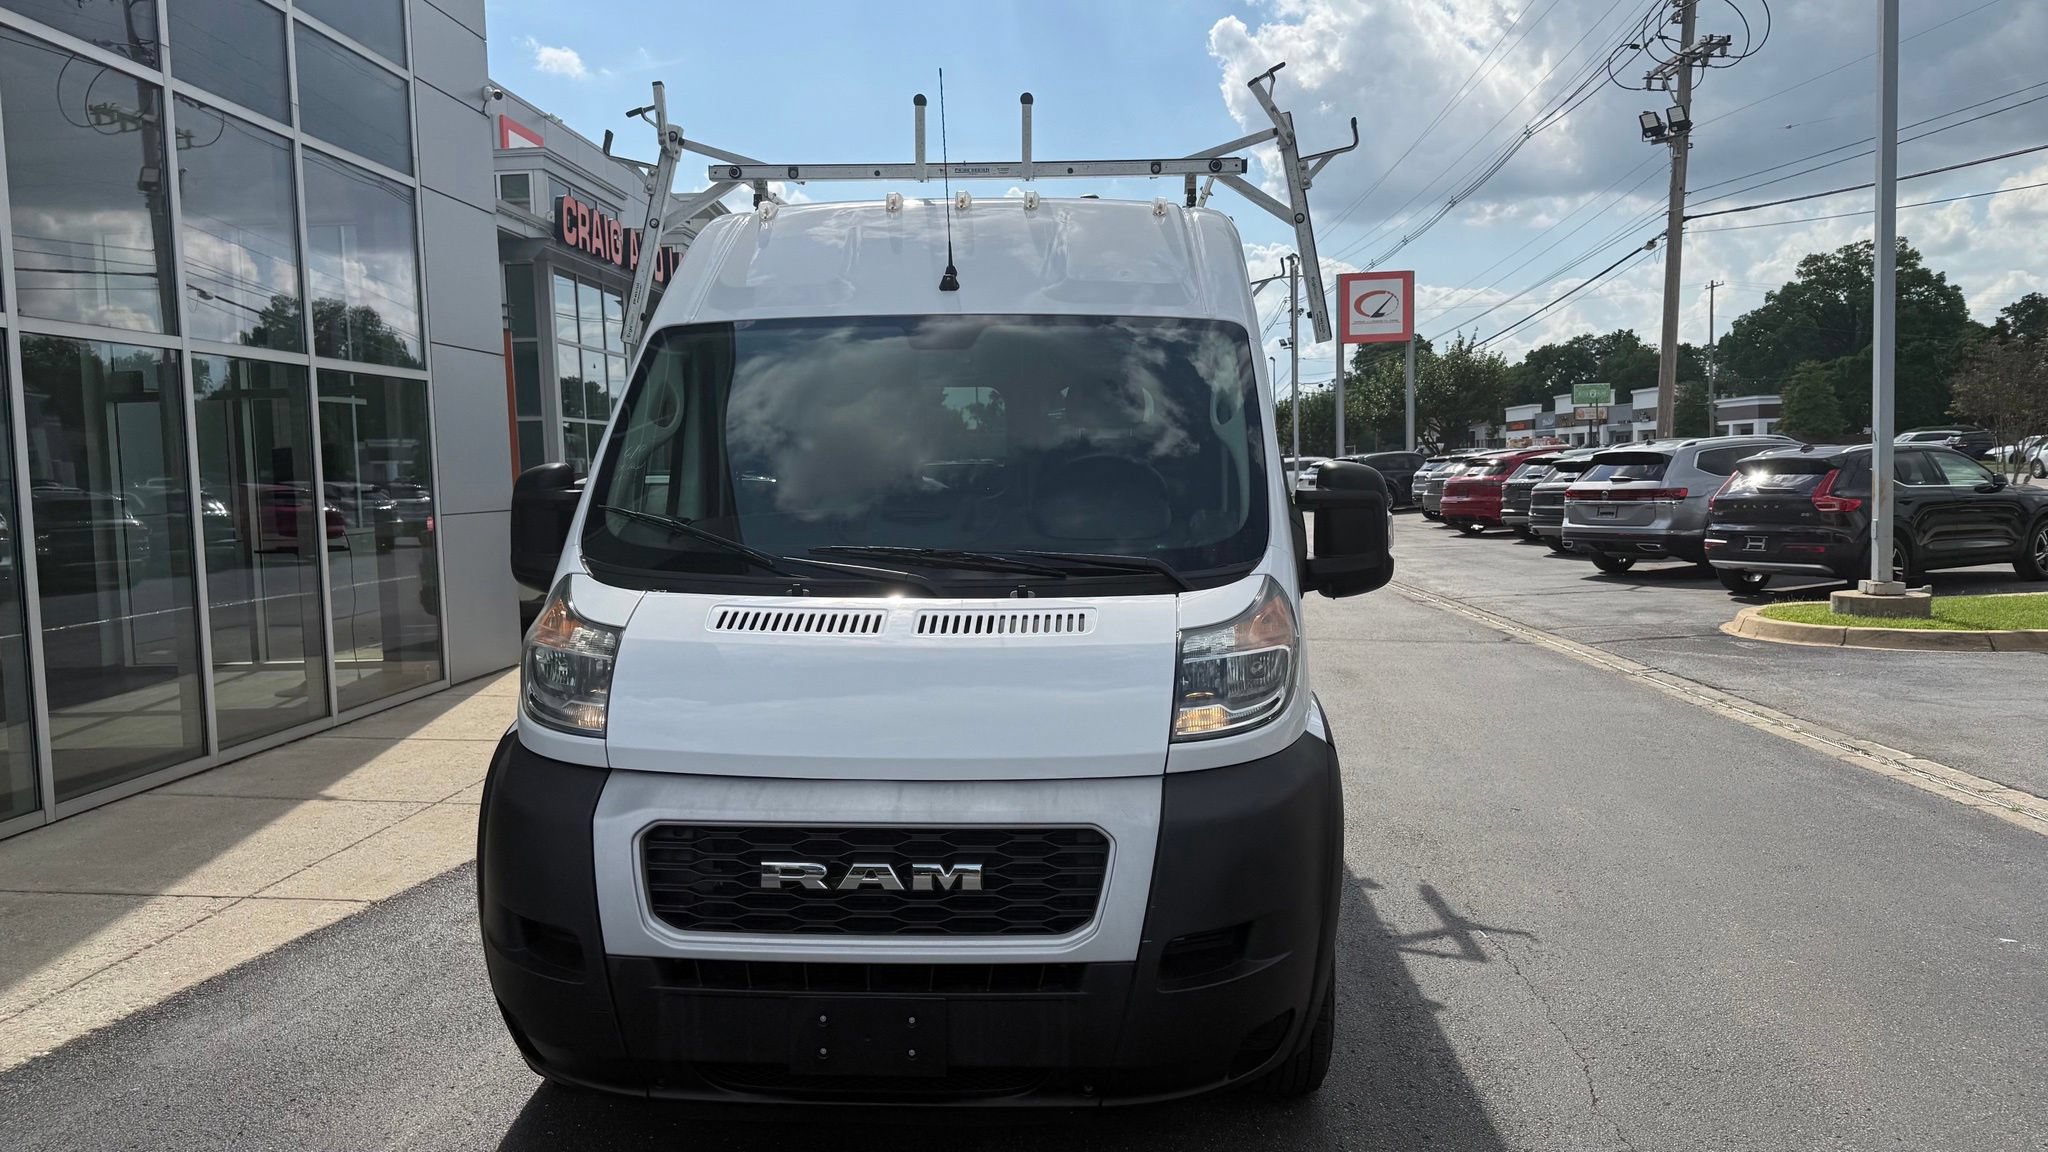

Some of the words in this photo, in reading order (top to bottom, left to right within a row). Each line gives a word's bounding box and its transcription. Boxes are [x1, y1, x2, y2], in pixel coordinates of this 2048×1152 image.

[562, 195, 623, 265] CRAIG
[630, 228, 664, 283] AD
[761, 861, 983, 891] RAM
